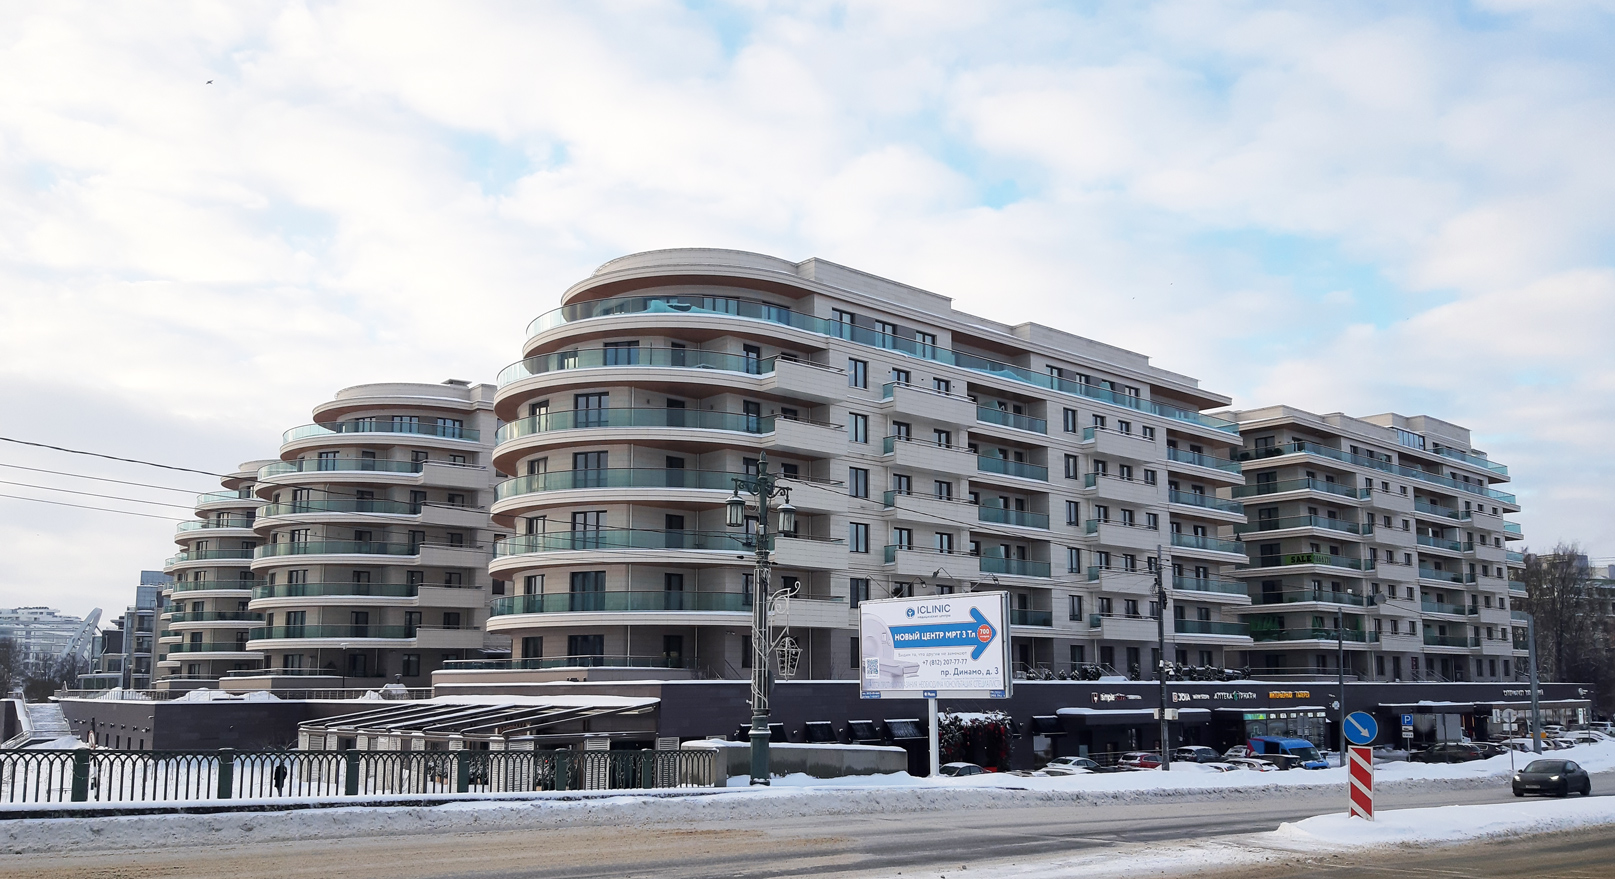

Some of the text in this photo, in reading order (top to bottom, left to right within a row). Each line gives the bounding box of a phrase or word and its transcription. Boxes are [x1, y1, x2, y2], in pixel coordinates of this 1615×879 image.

[1290, 555, 1312, 563] SALE
[917, 604, 951, 614] ICLINIC
[894, 630, 976, 641] НОВЫЙ ЦЕНТР МРТ 3 Тл
[929, 659, 942, 667] (812)
[943, 658, 968, 666] 207-77-77
[941, 670, 952, 678] пр.
[953, 667, 985, 677] Динамо,
[994, 666, 999, 675] 3
